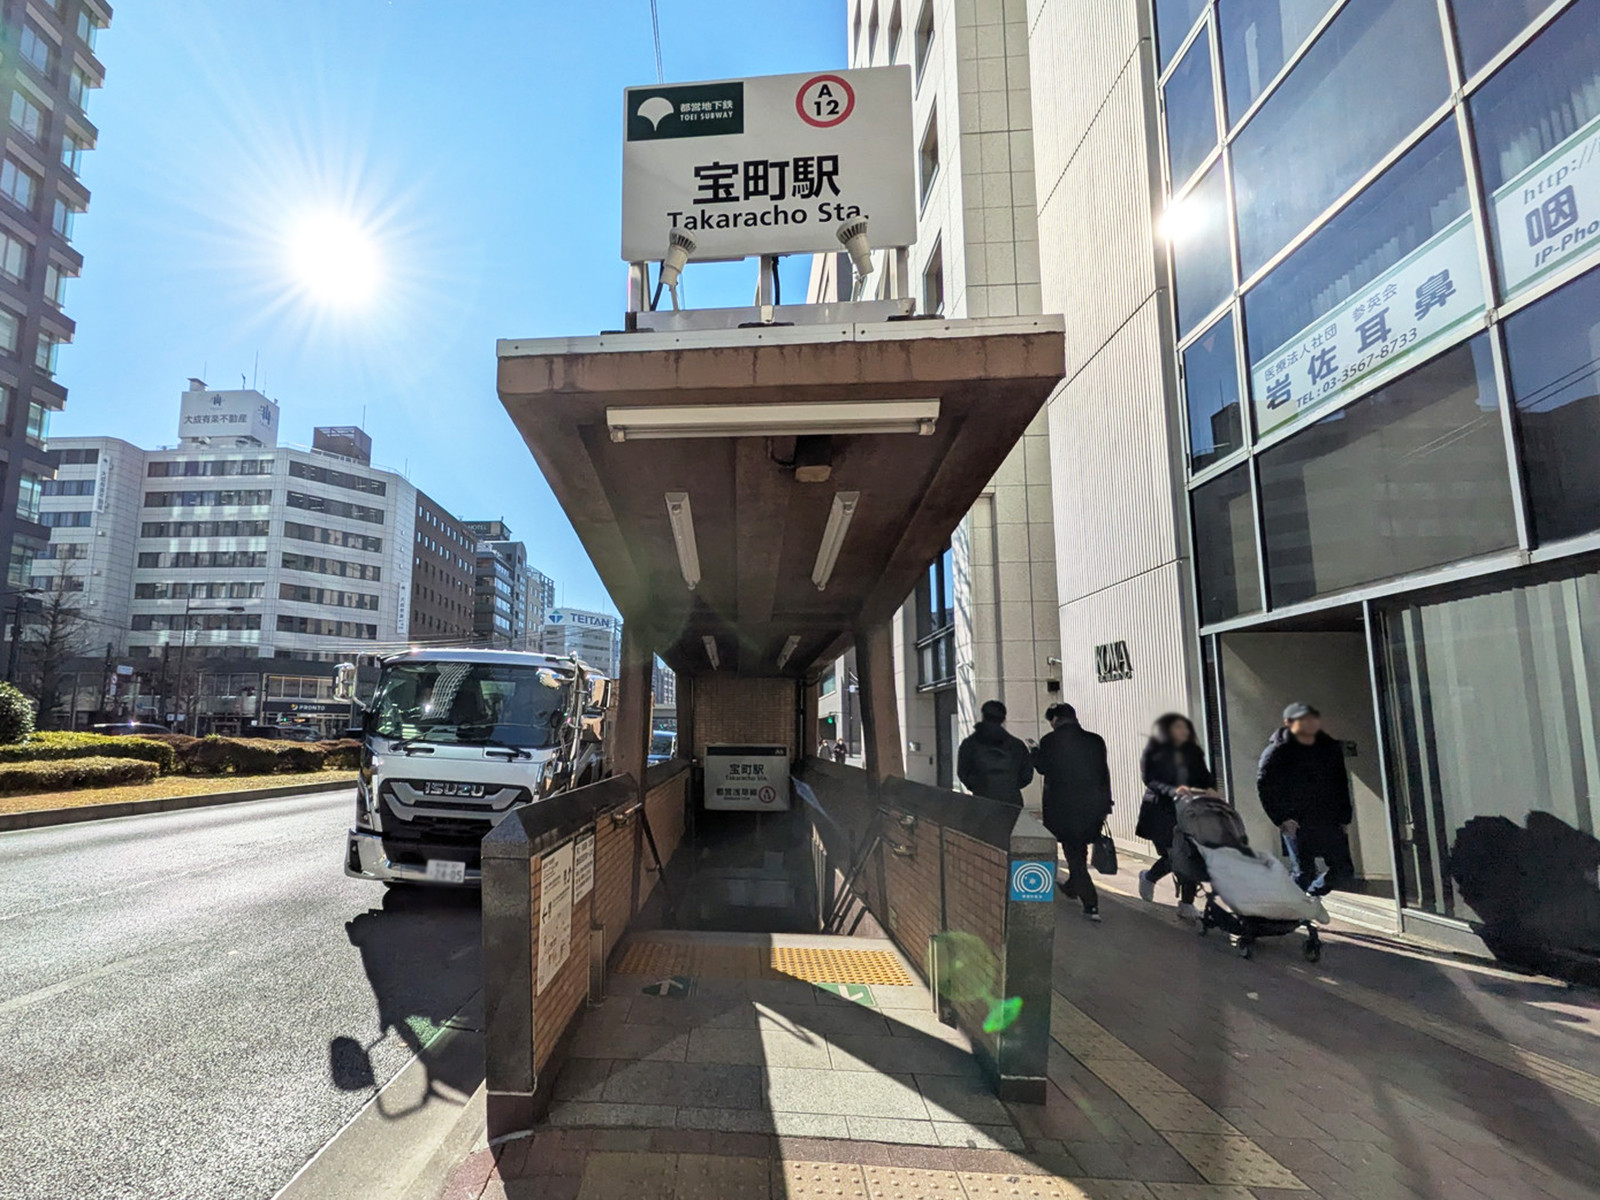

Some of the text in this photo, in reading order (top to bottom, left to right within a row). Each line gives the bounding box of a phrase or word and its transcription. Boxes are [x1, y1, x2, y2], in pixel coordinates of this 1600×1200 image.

[818, 84, 833, 98] A
[680, 99, 733, 111] 都営地下鉄
[814, 100, 839, 116] 12
[680, 110, 733, 121] TOEI SUBWAY
[693, 155, 841, 204] 宝町駅
[667, 205, 807, 231] Takaracho
[1525, 185, 1578, 247] 咽
[1264, 322, 1338, 381] 医療法人社団
[570, 613, 610, 627] TEITAN
[729, 764, 764, 774] 宝町駅
[425, 782, 484, 797] ISUZU
